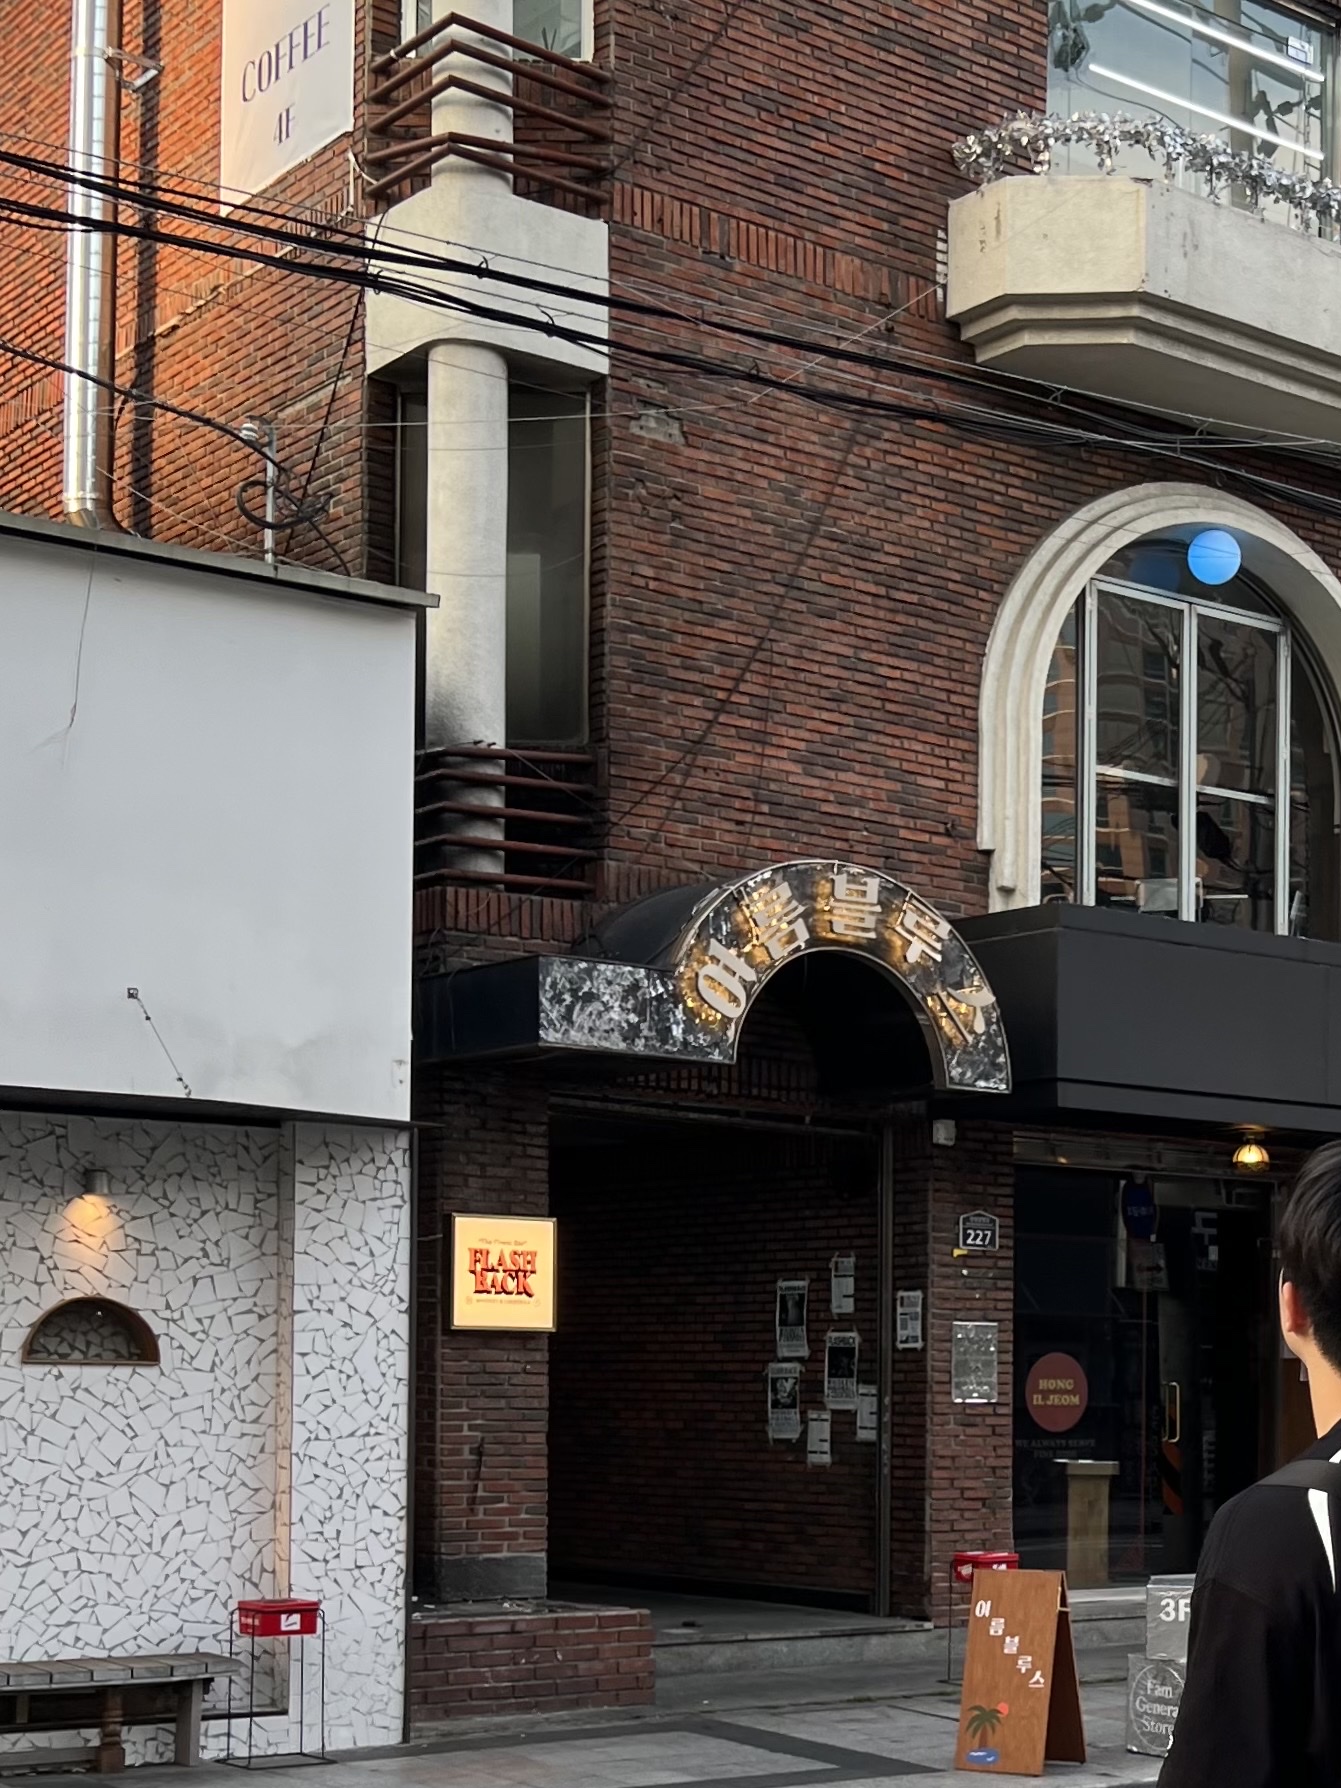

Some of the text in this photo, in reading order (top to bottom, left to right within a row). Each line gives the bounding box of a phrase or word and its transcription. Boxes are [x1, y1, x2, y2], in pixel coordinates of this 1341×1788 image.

[242, 3, 330, 103] COFFEE
[966, 1229, 992, 1245] 227
[468, 1247, 538, 1274] FLASH
[473, 1269, 535, 1298] BACK
[1039, 1379, 1074, 1391] HONG
[1046, 1394, 1080, 1406] JEOM
[1159, 1598, 1191, 1622] 3F
[1135, 1696, 1179, 1719] Genera
